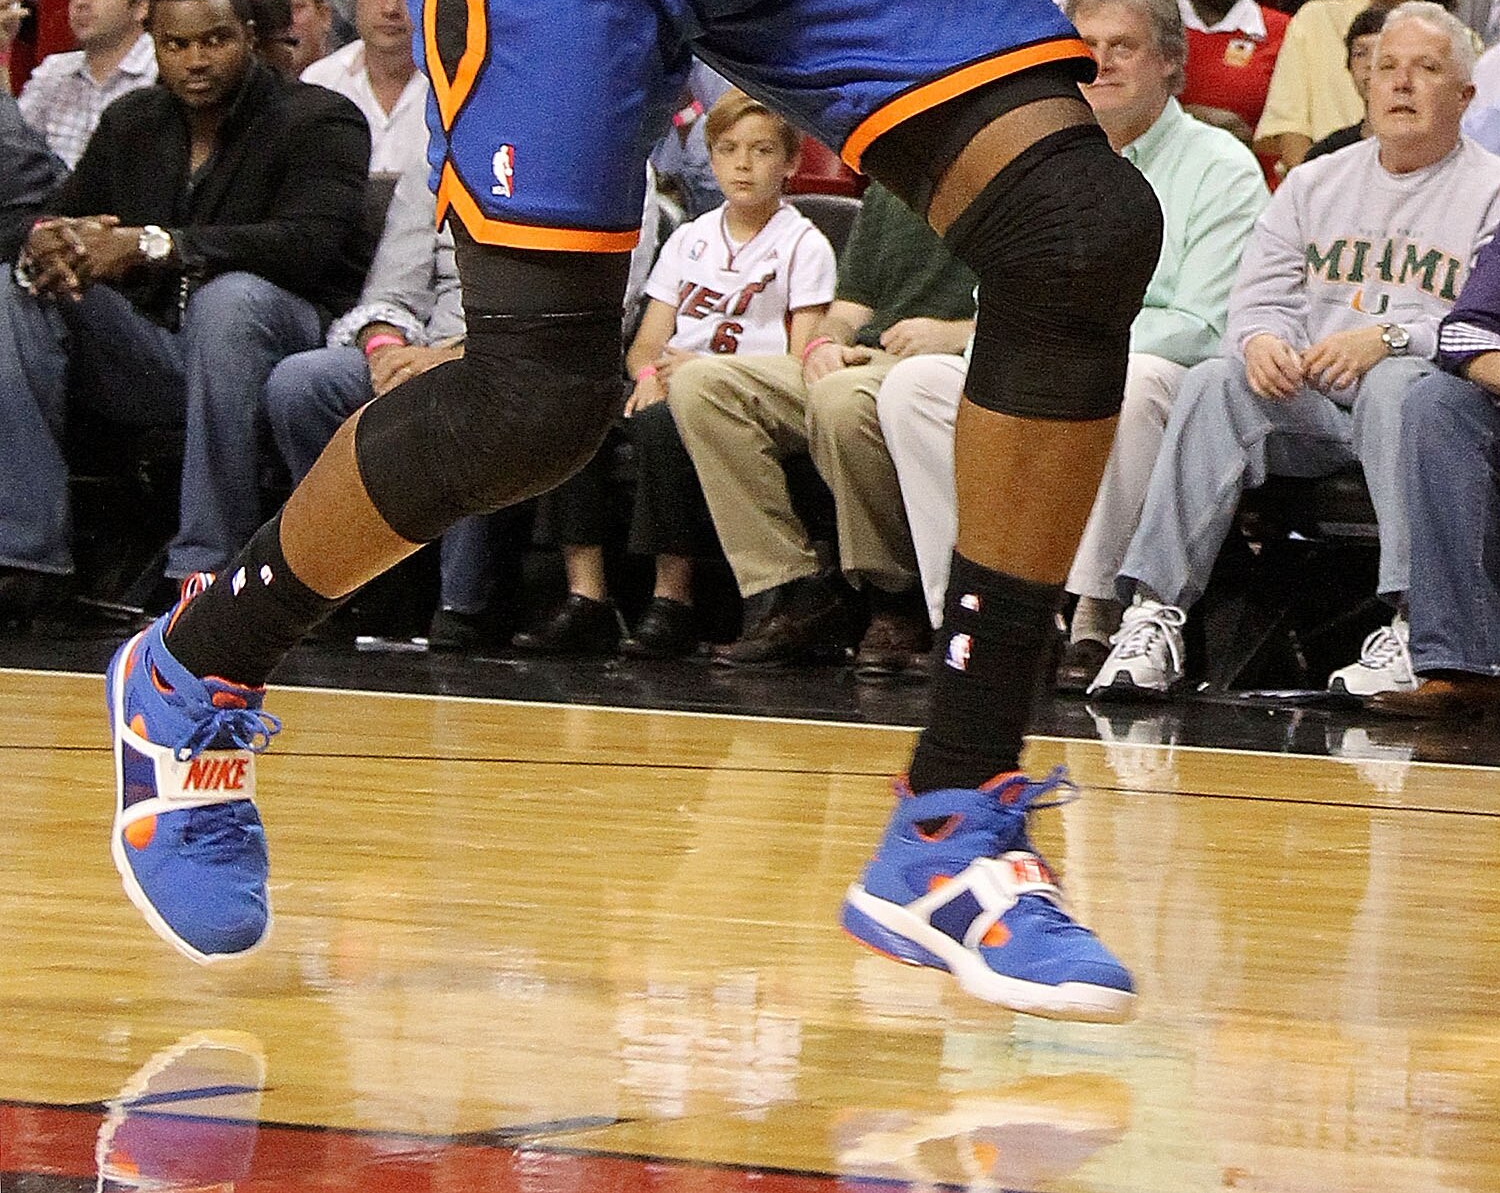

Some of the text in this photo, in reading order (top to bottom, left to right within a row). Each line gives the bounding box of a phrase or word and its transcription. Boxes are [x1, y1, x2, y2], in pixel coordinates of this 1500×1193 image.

[1305, 238, 1461, 302] MIAMI
[710, 322, 744, 354] 6
[182, 758, 249, 790] NIKE
